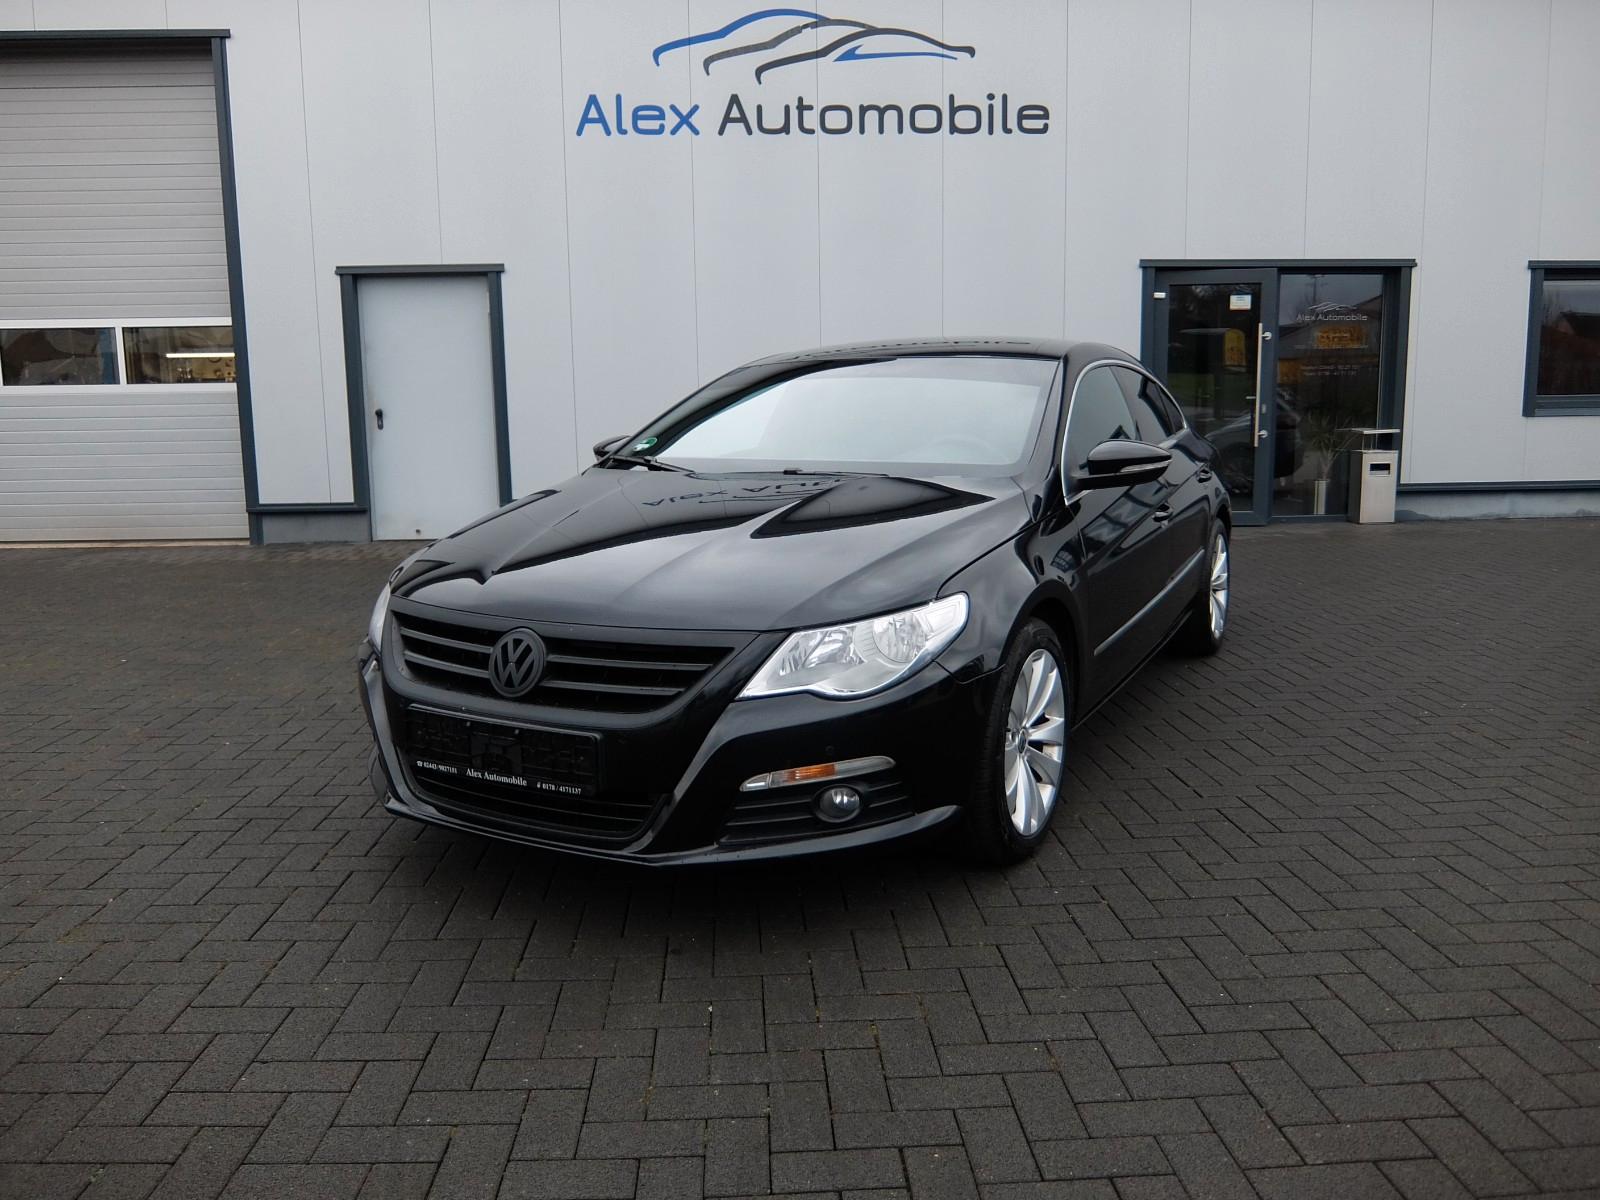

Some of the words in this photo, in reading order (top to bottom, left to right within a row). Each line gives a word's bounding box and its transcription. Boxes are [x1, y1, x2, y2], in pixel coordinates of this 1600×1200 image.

[576, 93, 700, 136] Alex
[717, 93, 1050, 136] Automobile
[1296, 313, 1316, 321] Alex
[1317, 313, 1368, 321] Automobile
[466, 767, 483, 780] Alex
[484, 771, 528, 787] Automobile
